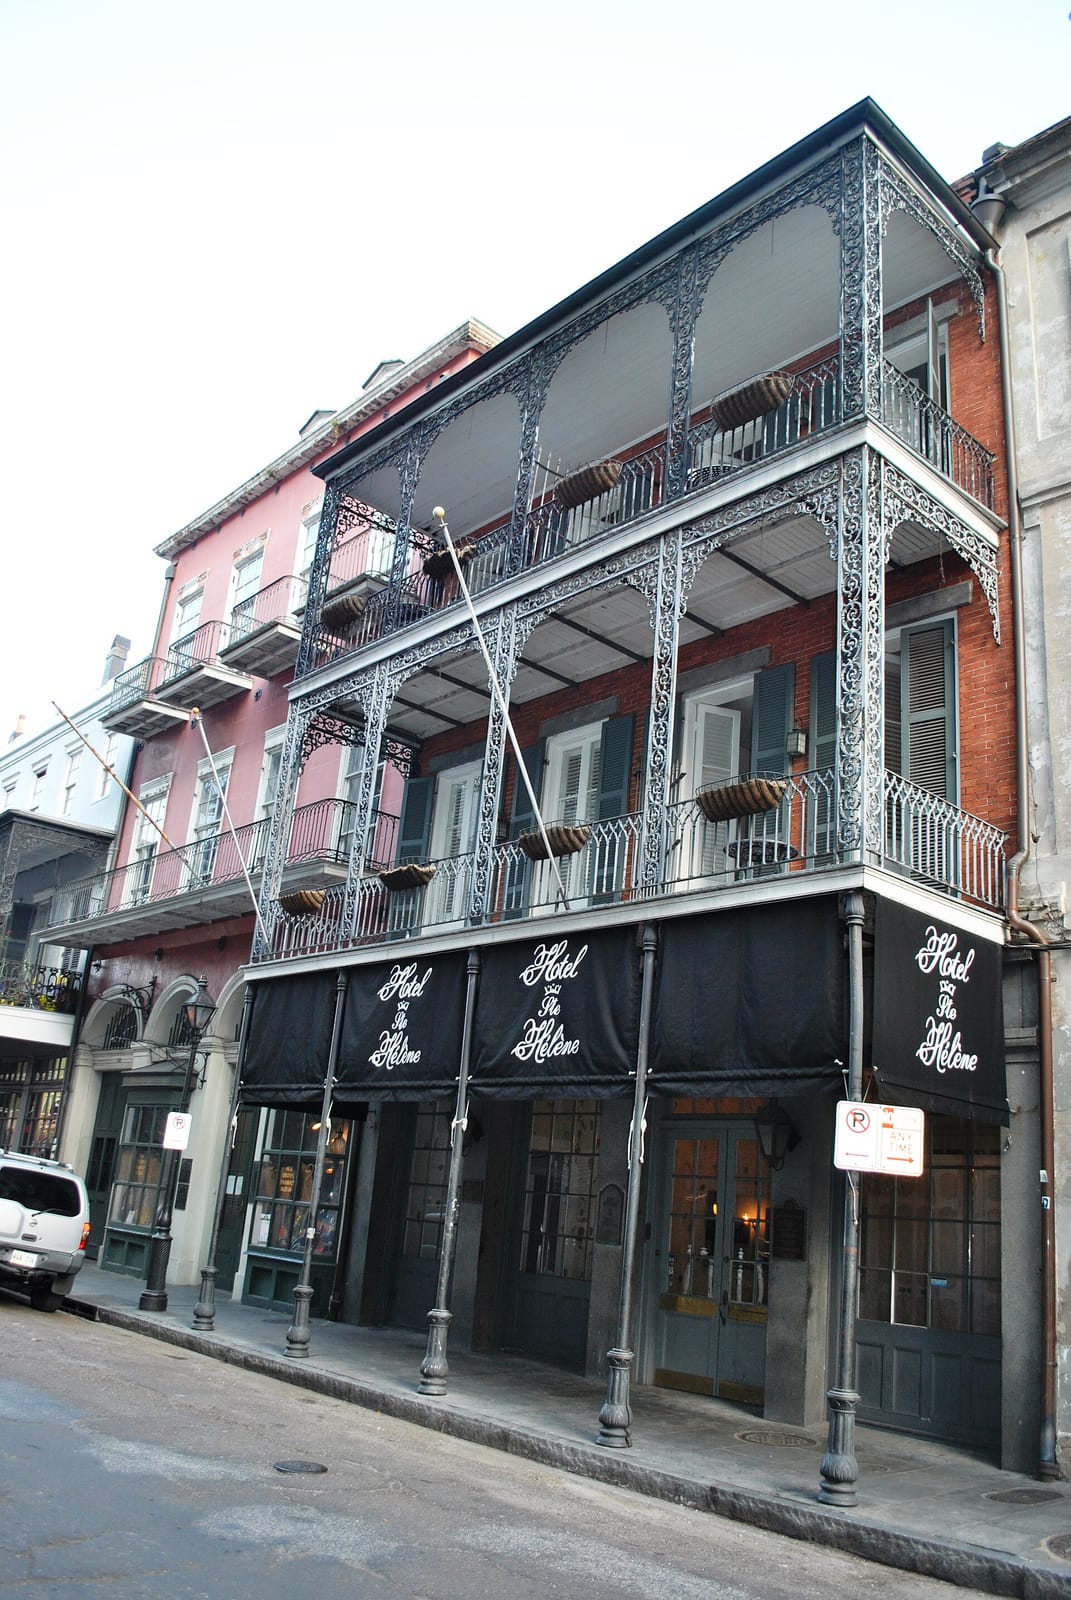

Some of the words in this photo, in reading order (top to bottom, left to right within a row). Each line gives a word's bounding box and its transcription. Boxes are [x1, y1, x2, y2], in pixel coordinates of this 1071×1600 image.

[519, 939, 588, 986] Hotel
[915, 925, 976, 983] Hotel
[377, 962, 432, 1001] Hotel
[538, 995, 561, 1017] Ste
[936, 994, 957, 1021] Ste
[368, 1030, 421, 1070] Hélène
[511, 1018, 580, 1064] Hélène
[916, 1016, 978, 1074] Hélène
[889, 1131, 912, 1142] ANY
[889, 1142, 913, 1154] TIME
